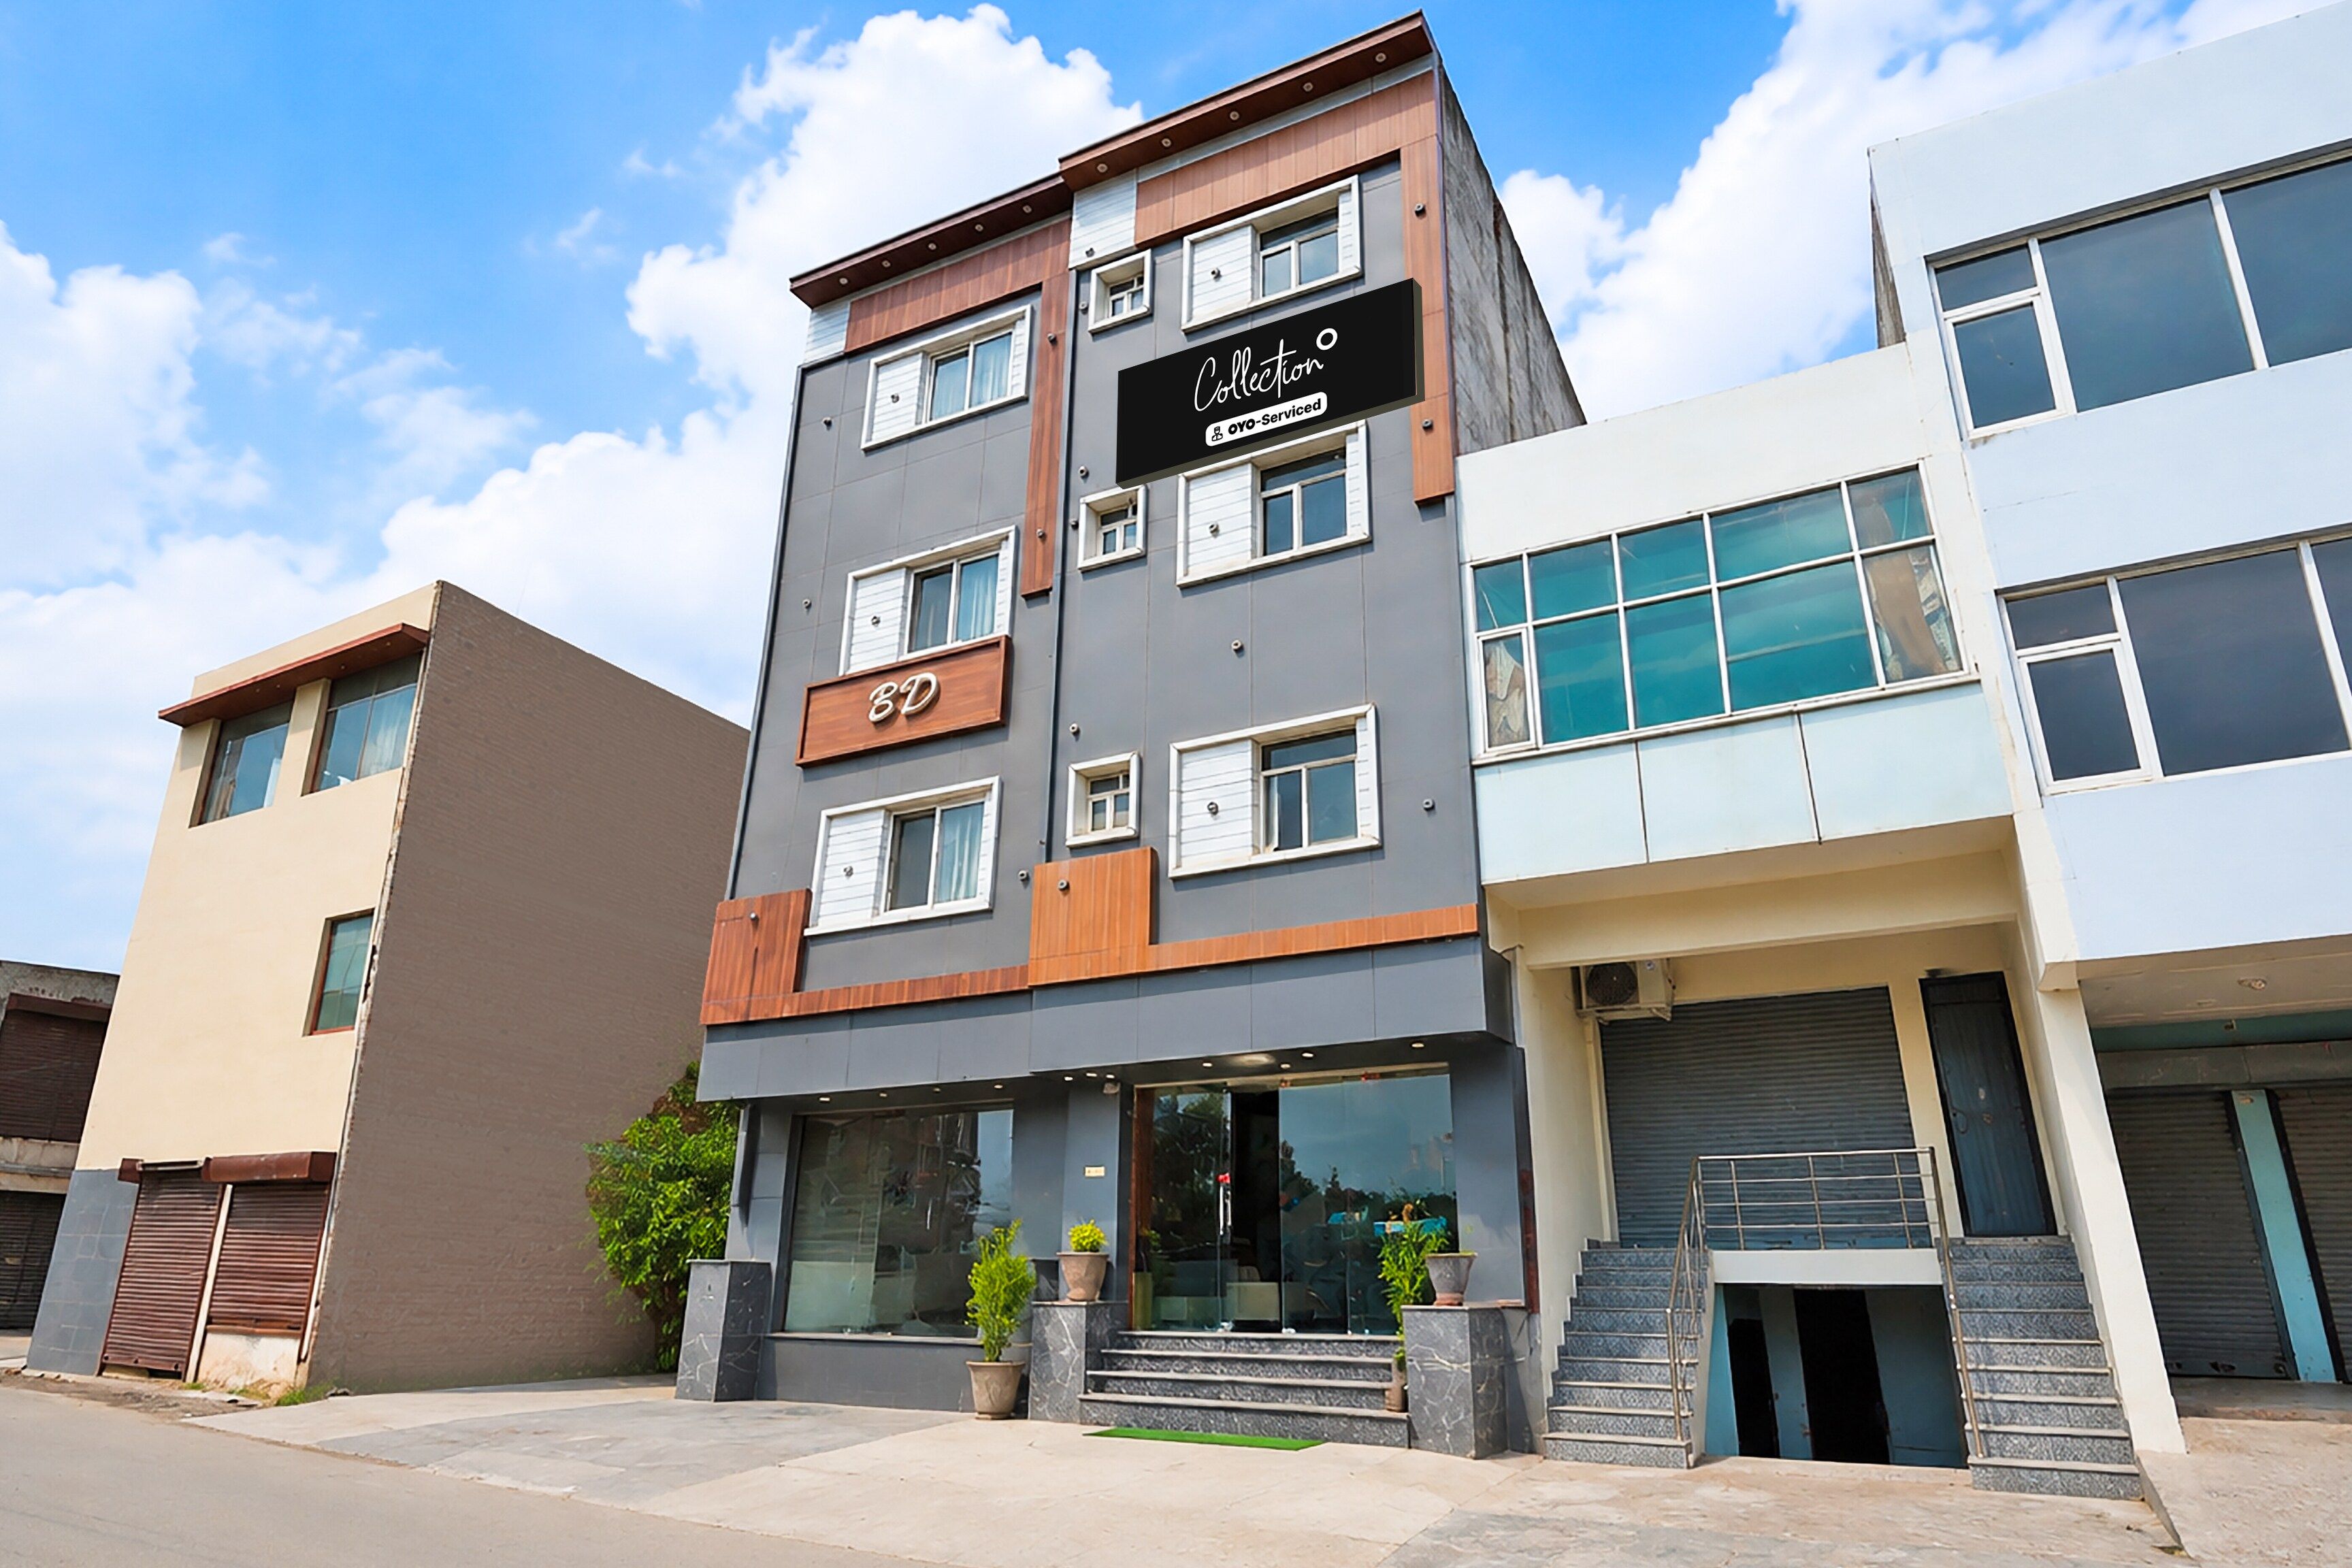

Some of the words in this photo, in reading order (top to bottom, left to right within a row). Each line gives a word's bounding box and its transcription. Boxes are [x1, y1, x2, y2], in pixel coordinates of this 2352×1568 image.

[1194, 338, 1324, 412] Collection
[1228, 397, 1322, 435] OYO-Serviced
[868, 672, 939, 723] BD
